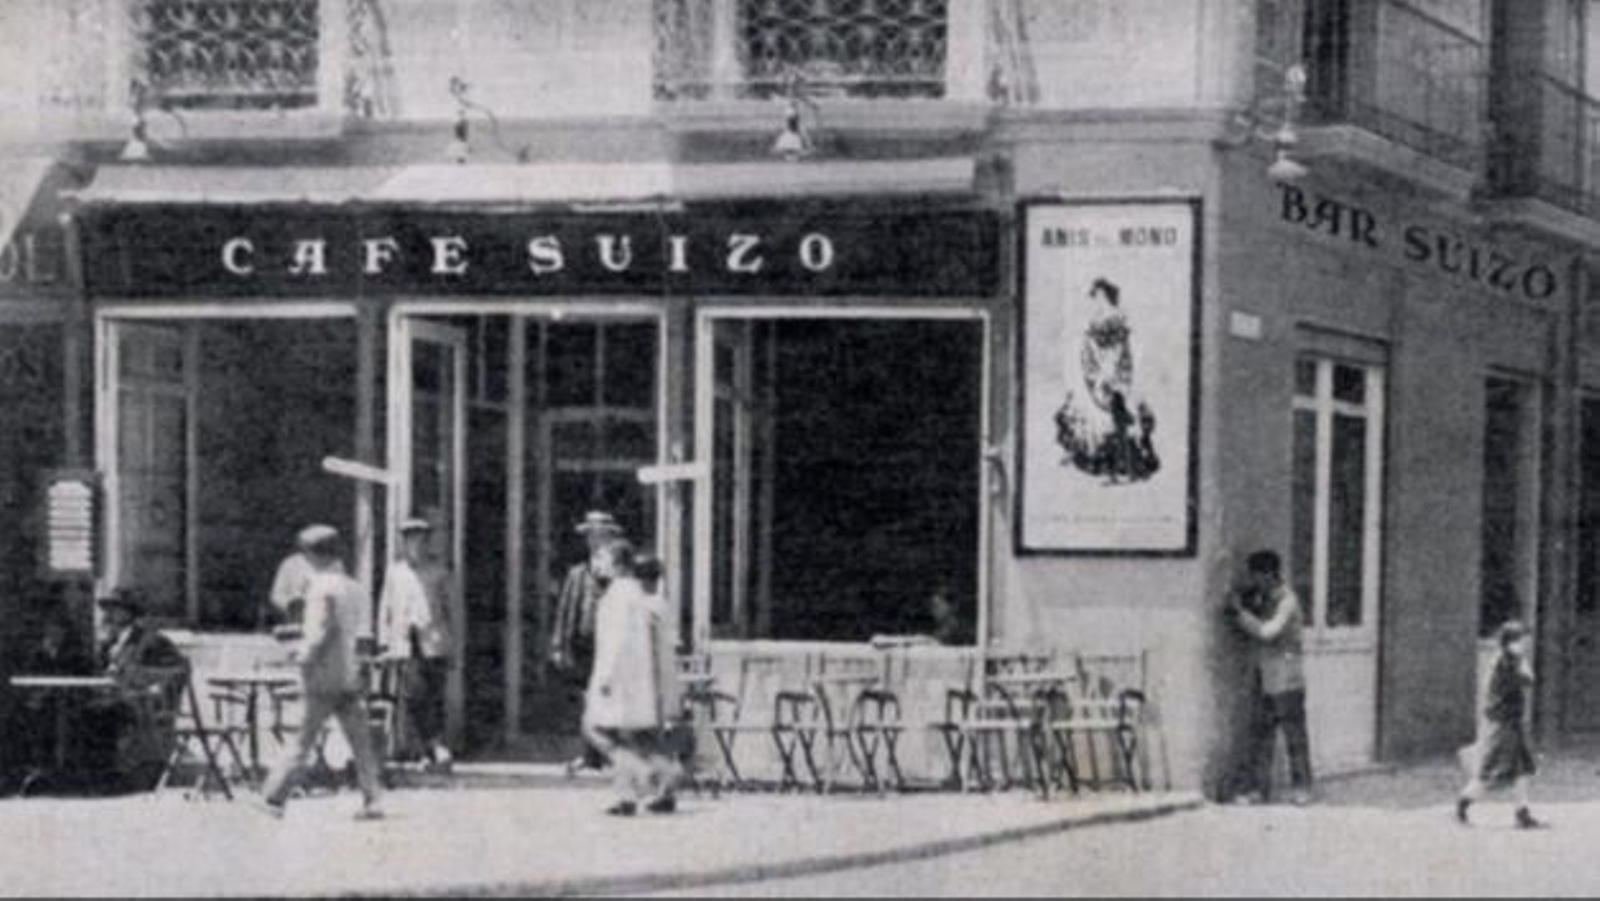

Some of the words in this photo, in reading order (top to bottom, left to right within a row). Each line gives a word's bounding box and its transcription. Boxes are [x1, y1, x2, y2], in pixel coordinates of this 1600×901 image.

[221, 236, 468, 275] CAFE
[528, 233, 834, 275] SUIZO
[1276, 181, 1379, 248] BAR
[1404, 225, 1557, 300] SUIZO
